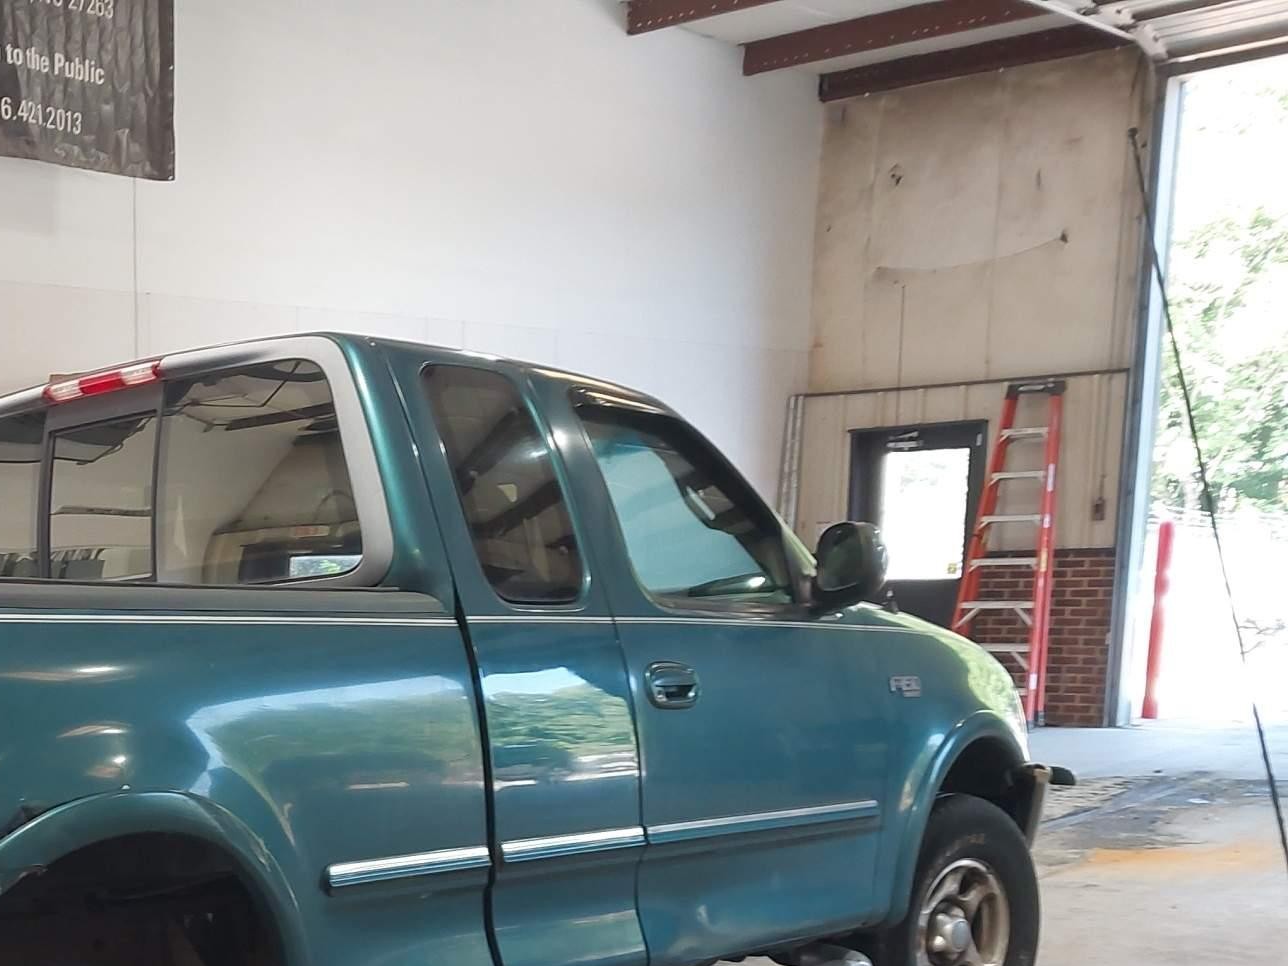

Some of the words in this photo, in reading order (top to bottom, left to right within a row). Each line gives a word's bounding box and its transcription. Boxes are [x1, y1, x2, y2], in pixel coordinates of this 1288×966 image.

[6, 44, 23, 66] to
[25, 50, 50, 73] the
[54, 53, 105, 85] Public
